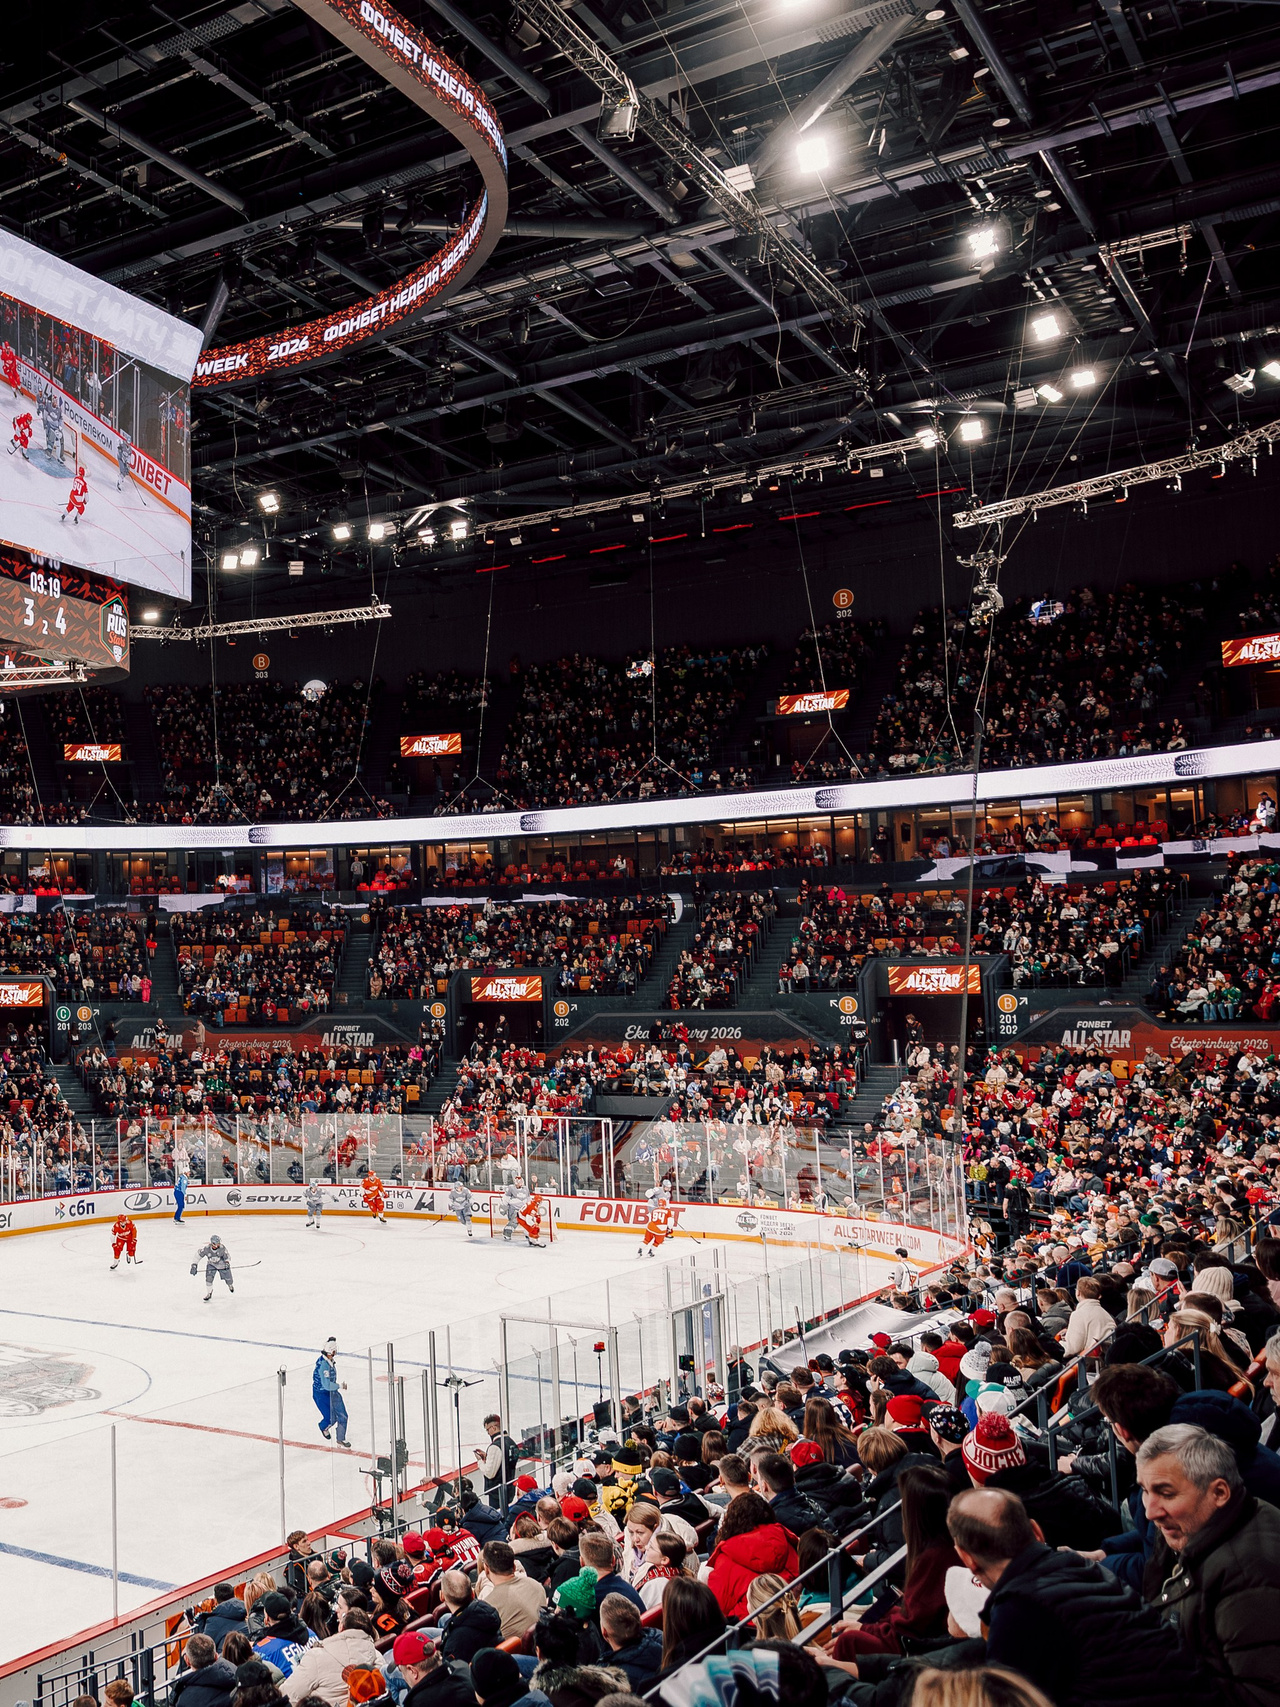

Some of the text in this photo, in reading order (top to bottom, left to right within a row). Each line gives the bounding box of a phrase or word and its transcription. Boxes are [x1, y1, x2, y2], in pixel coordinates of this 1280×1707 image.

[360, 1, 421, 63] ФОНБЕТ
[421, 53, 474, 112] НЕДЕЛЯ
[323, 237, 471, 343] ФОНБЕТ НЕДЕЛЯ ЗВЕЗД
[94, 295, 168, 351] МАТЧ
[267, 336, 310, 361] 2026
[196, 353, 249, 377] WEEK
[63, 400, 113, 451] Ростелеком
[30, 572, 61, 598] 03:19
[839, 592, 849, 605] B
[24, 598, 35, 626] 3
[112, 602, 123, 615] KHL
[836, 609, 852, 618] 302
[42, 619, 48, 635] 2
[55, 607, 66, 635] 4
[107, 615, 127, 636] RUS
[108, 631, 126, 647] Stars
[258, 656, 266, 668] B
[559, 1004, 565, 1014] B
[845, 1000, 853, 1011] B
[1003, 998, 1011, 1009] B
[60, 1009, 67, 1018] C
[82, 1009, 88, 1018] B
[435, 1006, 441, 1015] B
[554, 1018, 569, 1026] 202
[840, 1016, 857, 1025] 202
[999, 1015, 1017, 1024] 201
[57, 1022, 70, 1031] 201
[78, 1022, 92, 1031] 203
[710, 1026, 742, 1039] 2026
[999, 1025, 1018, 1034] 202
[272, 1039, 291, 1049] 2026
[1170, 1036, 1269, 1050] Ekaterinburg 2026
[245, 1193, 303, 1203] SOYUZ
[69, 1200, 95, 1217] сбп
[349, 1200, 356, 1209] &
[579, 1202, 686, 1228] FONBT
[652, 1212, 666, 1222] 94
